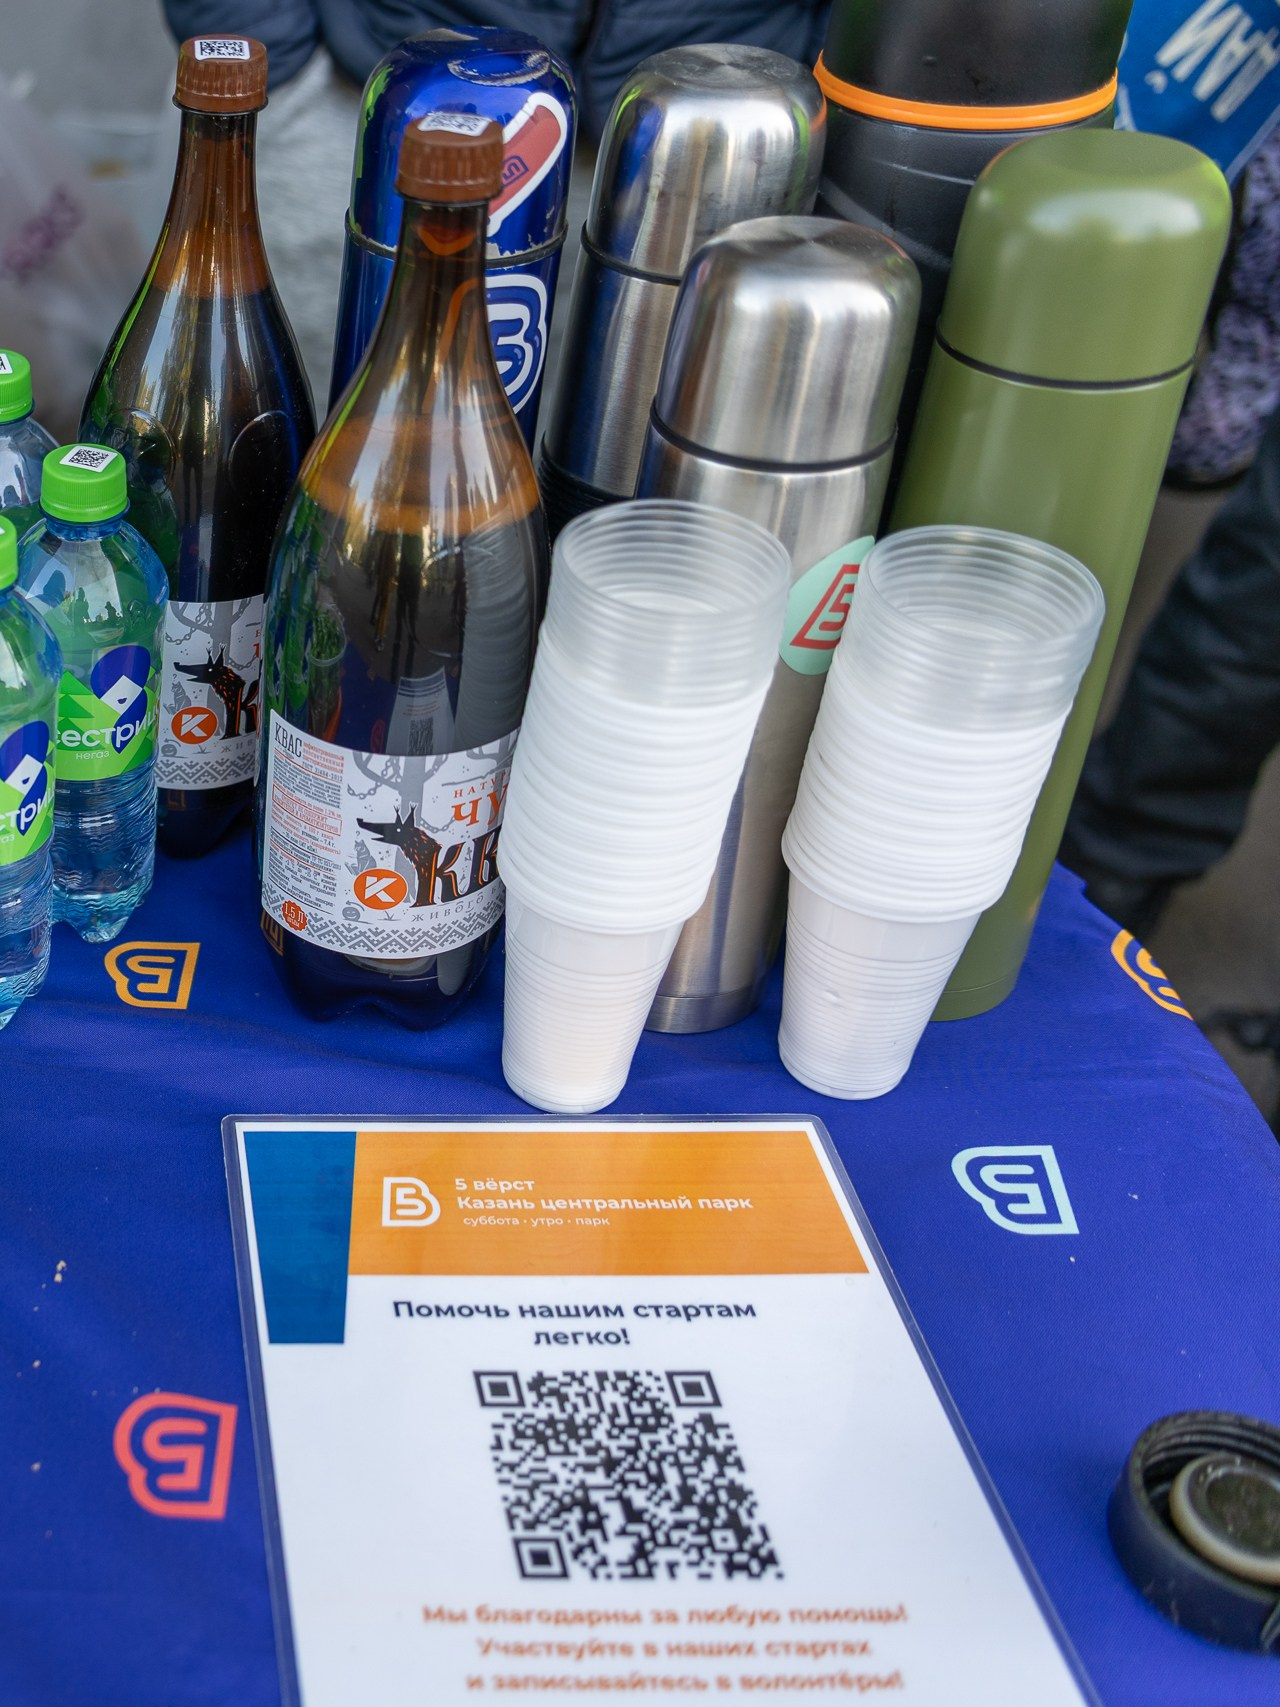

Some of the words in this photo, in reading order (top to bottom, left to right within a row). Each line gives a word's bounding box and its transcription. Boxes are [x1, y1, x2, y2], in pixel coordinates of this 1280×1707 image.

[274, 721, 302, 758] КВАС
[75, 750, 110, 761] негаз
[455, 1178, 468, 1192] 5
[473, 1178, 535, 1194] вёрст
[457, 1196, 535, 1210] Казань
[541, 1195, 692, 1211] центральный
[698, 1198, 754, 1213] парк
[463, 1215, 520, 1227] суббота
[531, 1217, 564, 1227] утро
[575, 1217, 610, 1227] парк
[392, 1301, 510, 1319] Помочь
[519, 1303, 625, 1319] нашим
[633, 1304, 757, 1322] стартам
[534, 1328, 631, 1346] легко!
[422, 1606, 468, 1624] Мы
[475, 1604, 642, 1627] благодарны
[650, 1609, 679, 1624] за
[688, 1604, 781, 1628] любую
[788, 1603, 908, 1625] помощь!
[477, 1637, 634, 1661] Участвуйте
[642, 1642, 658, 1657] в
[666, 1641, 757, 1657] наших
[765, 1641, 872, 1660] стартах
[466, 1675, 484, 1691] и
[493, 1671, 708, 1691] записывайтесь
[716, 1675, 731, 1691] в
